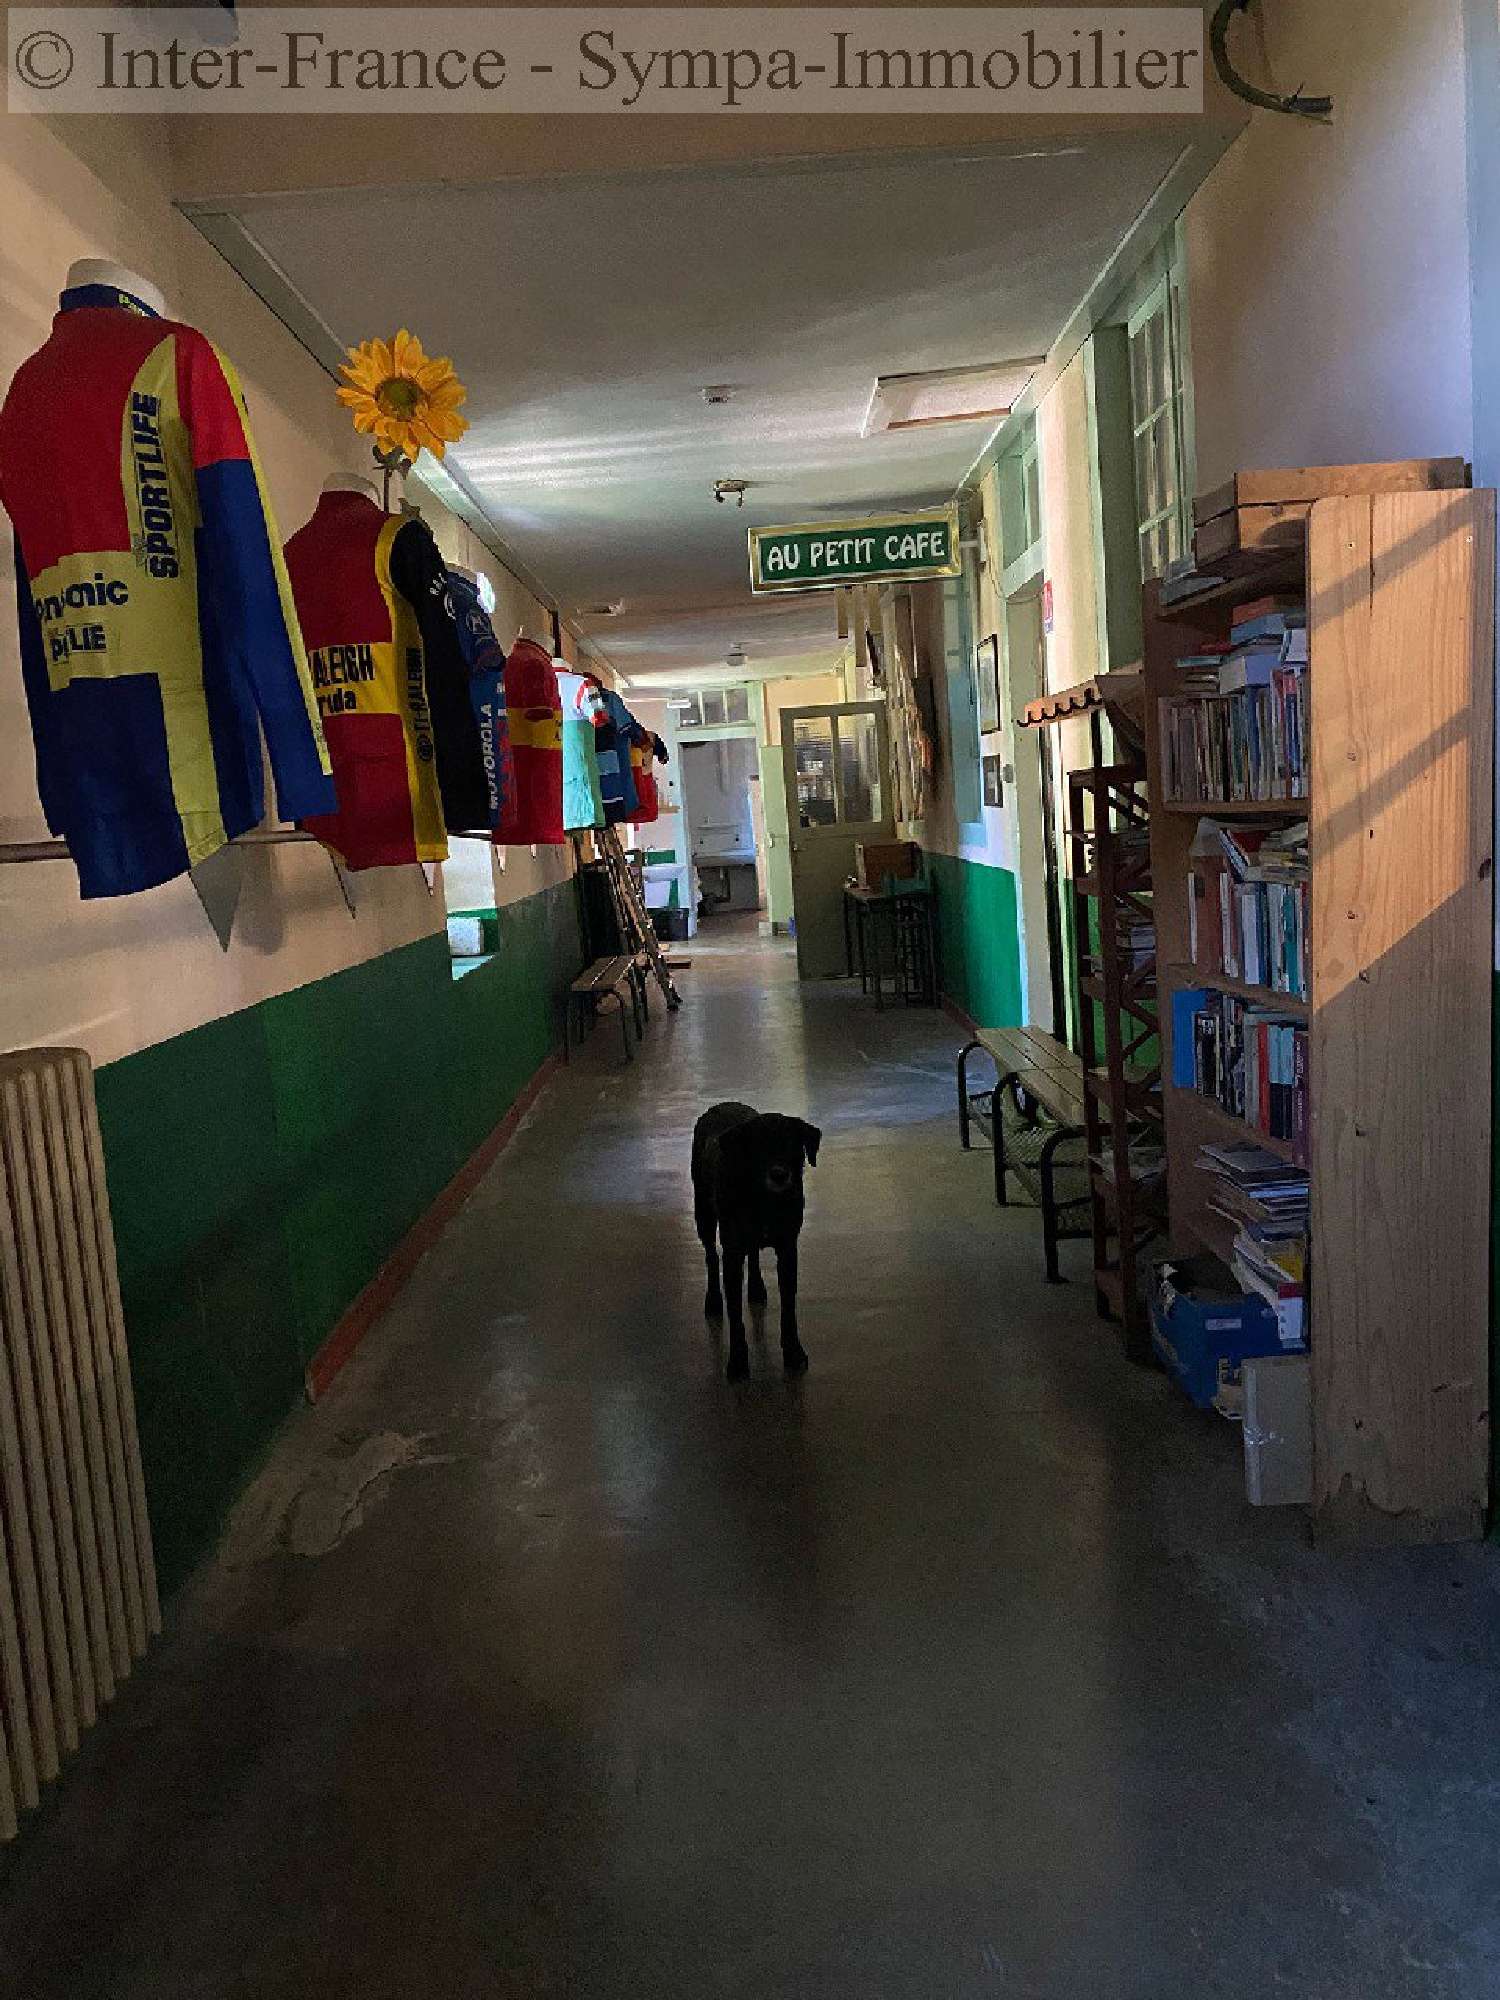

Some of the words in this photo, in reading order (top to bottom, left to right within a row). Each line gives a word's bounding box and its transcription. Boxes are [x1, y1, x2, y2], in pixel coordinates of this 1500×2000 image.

[132, 391, 178, 578] SPORTLIFE
[767, 543, 800, 571] AU
[810, 538, 876, 568] PETIT
[883, 530, 946, 562] CAFE
[308, 643, 375, 689] ALEIGH
